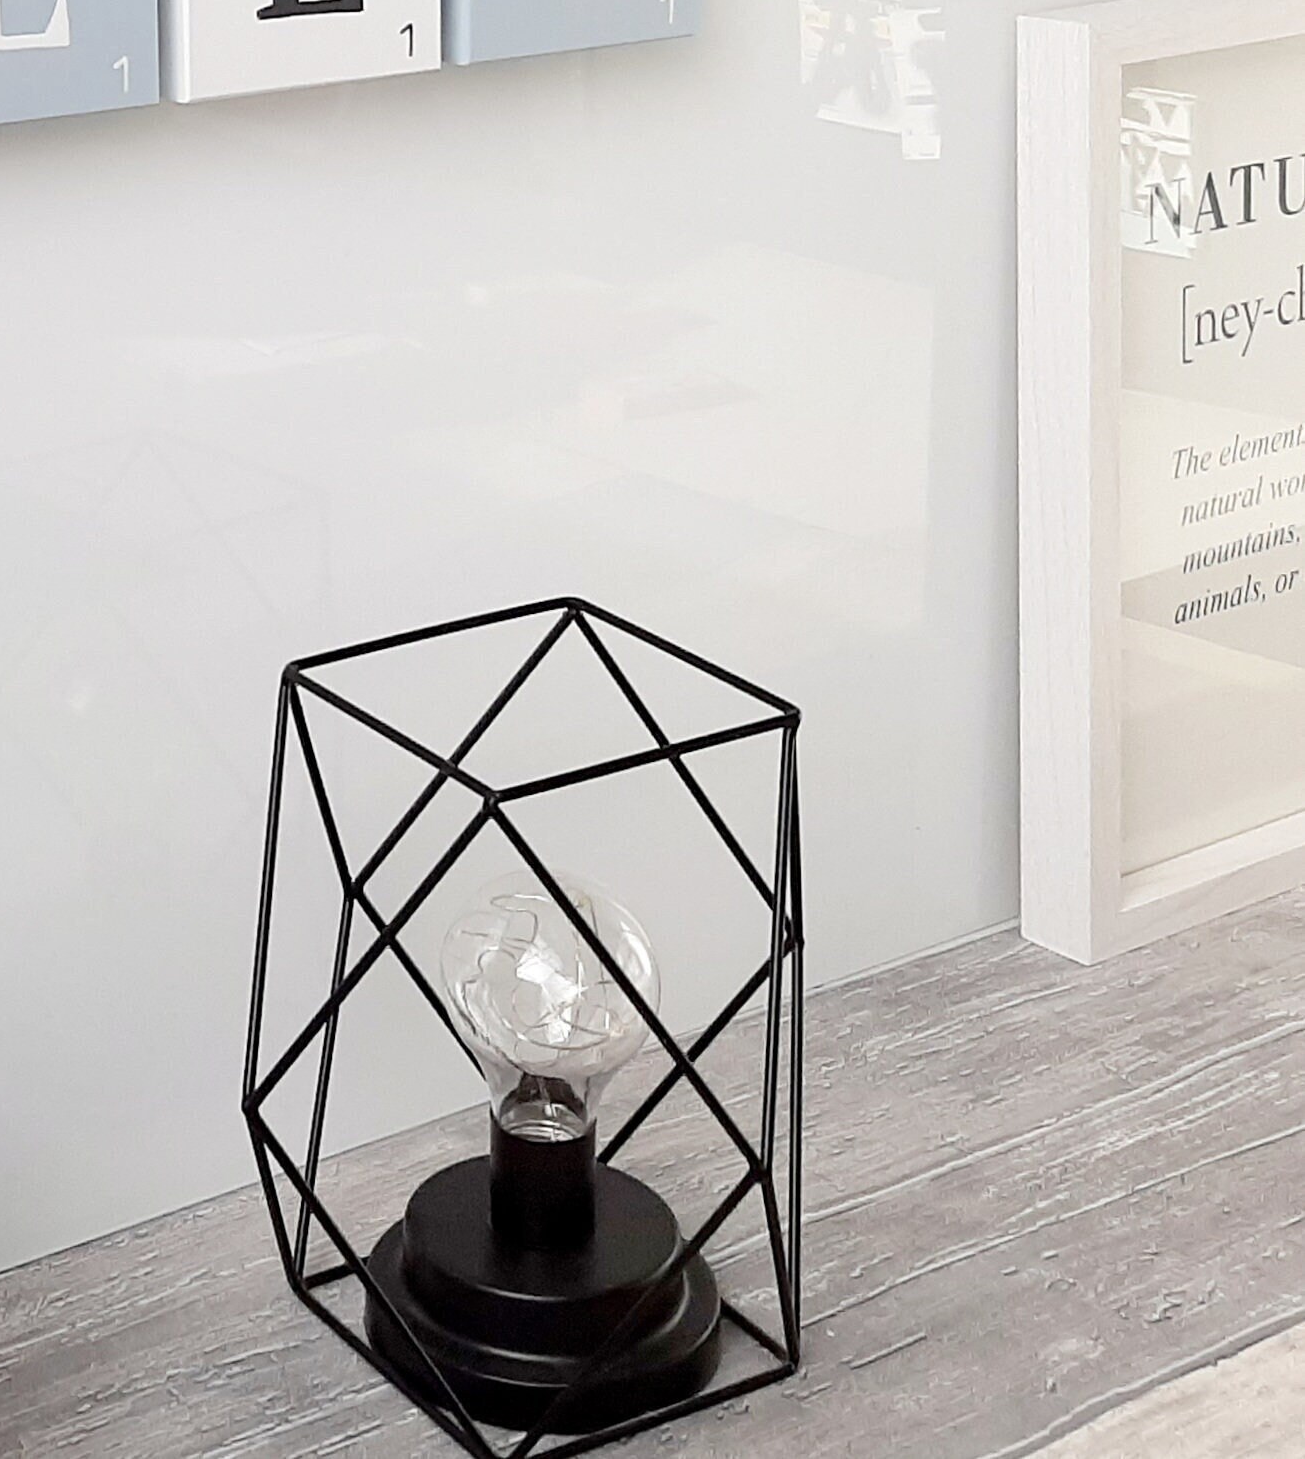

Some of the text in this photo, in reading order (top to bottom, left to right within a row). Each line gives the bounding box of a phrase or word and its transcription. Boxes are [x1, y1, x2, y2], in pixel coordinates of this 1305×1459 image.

[399, 23, 415, 57] 1
[113, 56, 131, 94] 1
[1173, 424, 1305, 480] The element
[1181, 475, 1264, 527] natural
[1174, 570, 1300, 624] animals, or
